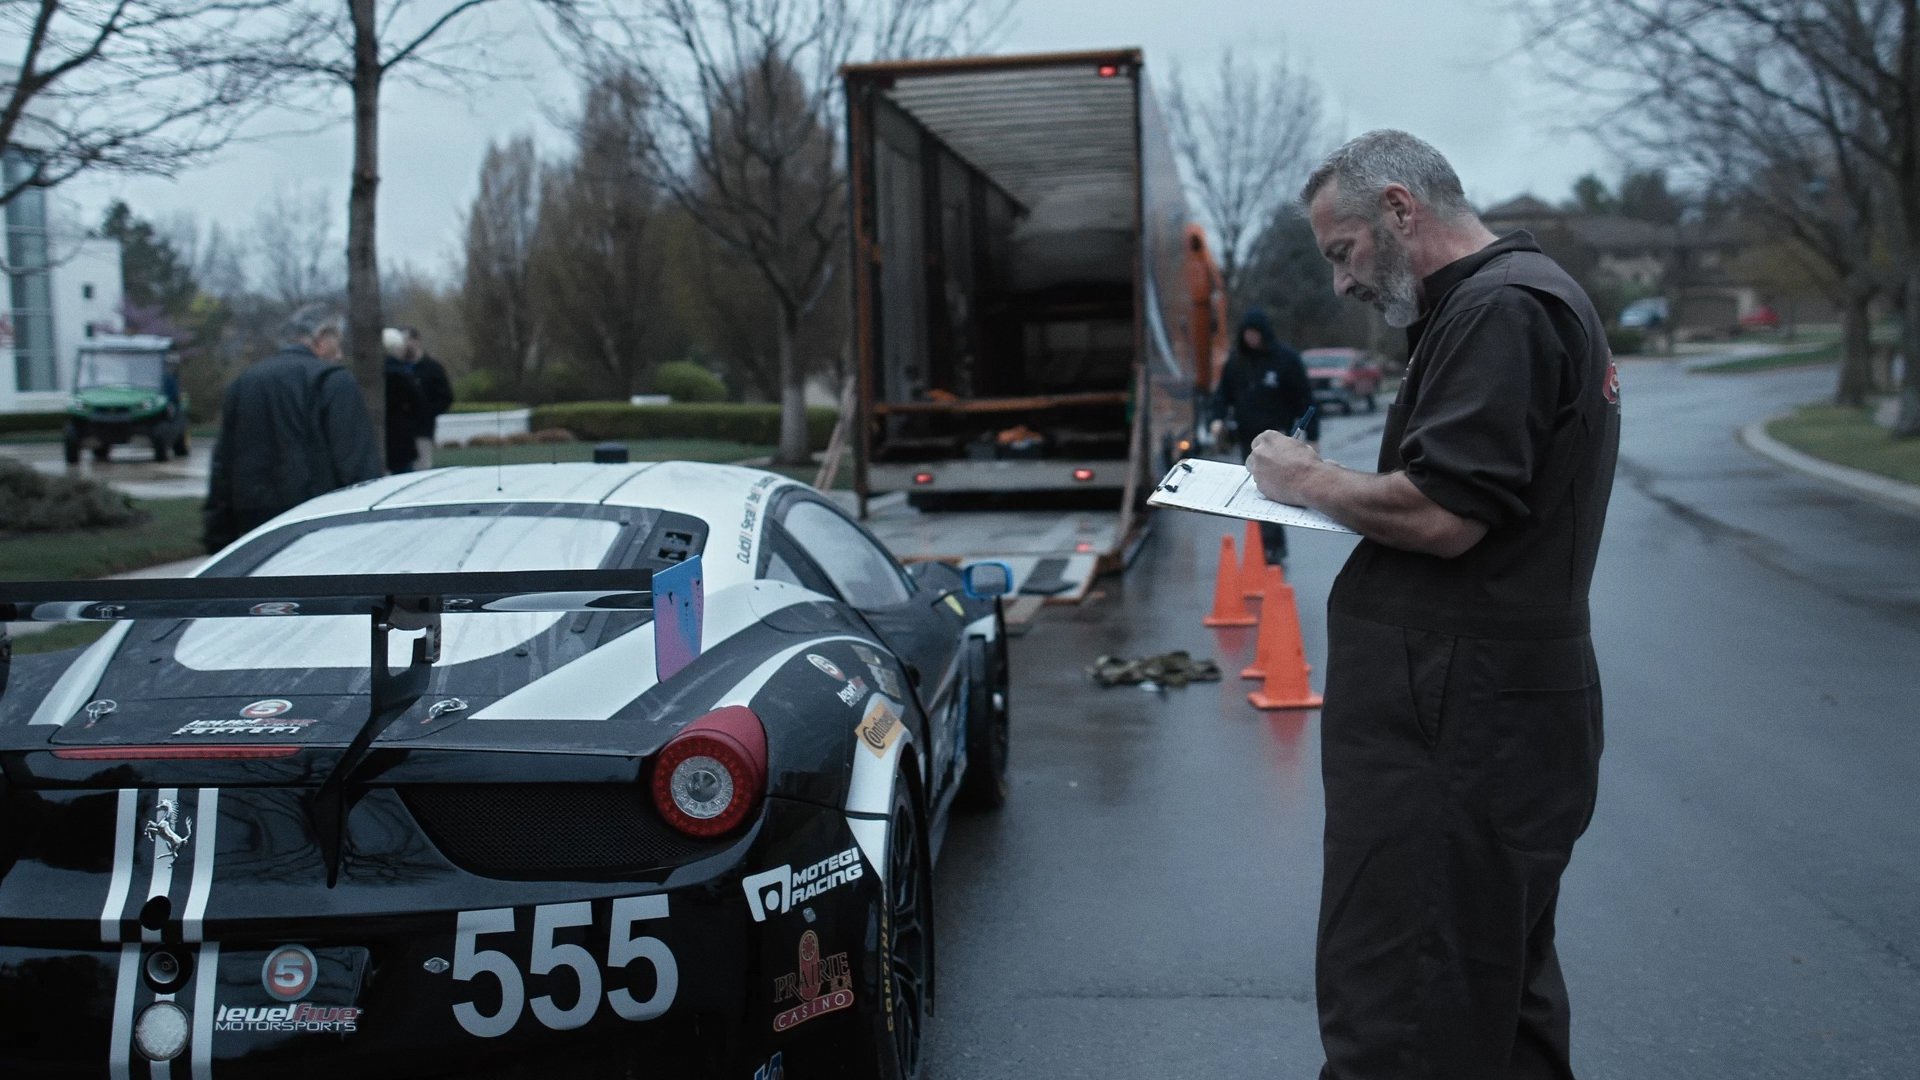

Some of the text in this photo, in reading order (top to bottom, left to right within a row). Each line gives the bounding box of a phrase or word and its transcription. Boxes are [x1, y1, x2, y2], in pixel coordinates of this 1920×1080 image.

[792, 847, 860, 888] MOTEGI
[792, 863, 863, 906] RACING
[274, 958, 305, 988] 5
[452, 893, 679, 1038] 555
[773, 952, 850, 1005] PRAIRIE
[215, 1021, 357, 1032] MOTORSPORTS
[778, 993, 846, 1027] CASINO
